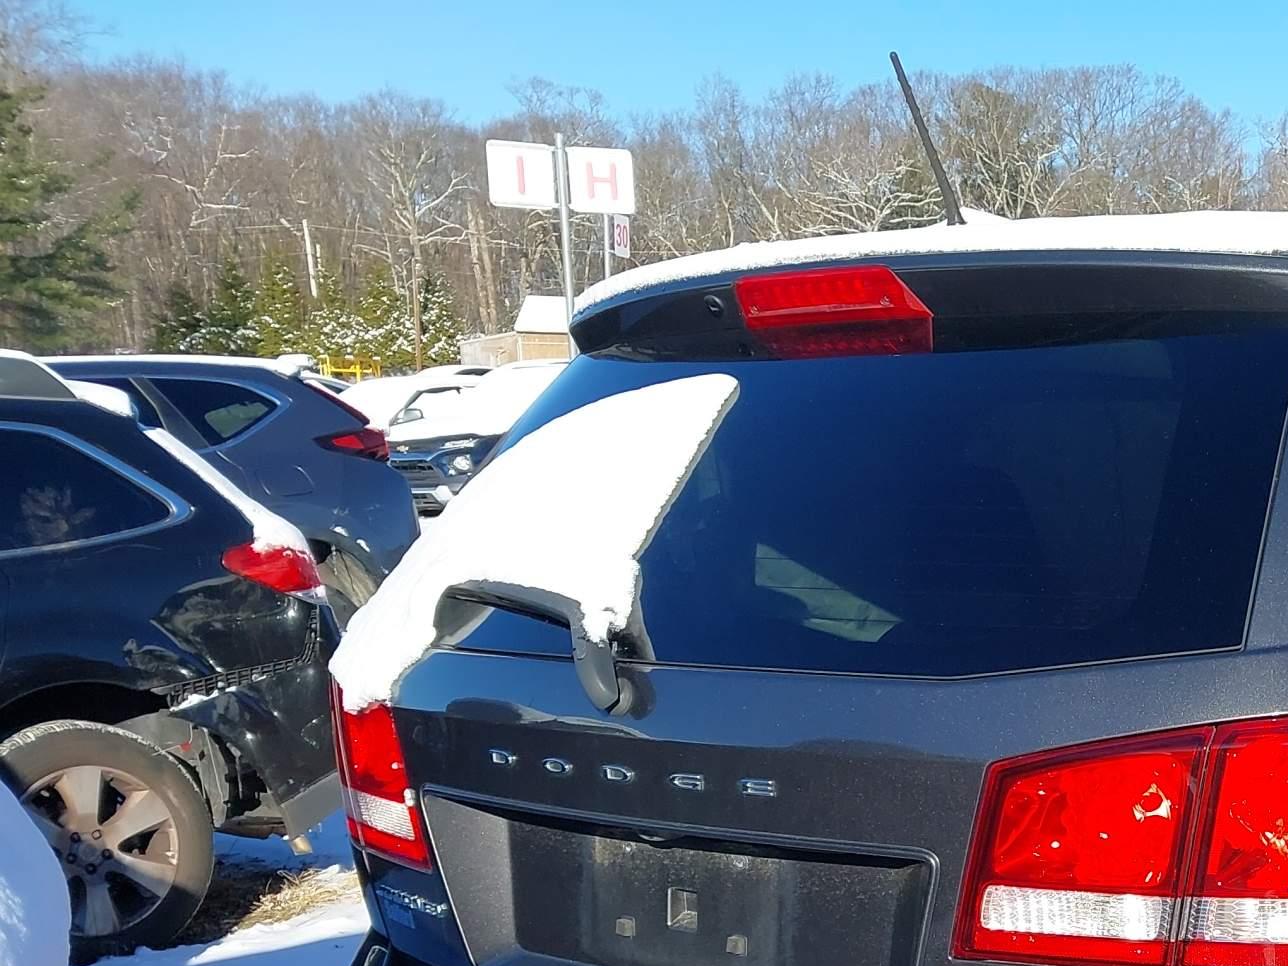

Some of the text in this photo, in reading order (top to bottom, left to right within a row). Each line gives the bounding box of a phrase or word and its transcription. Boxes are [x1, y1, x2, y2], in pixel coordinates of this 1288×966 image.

[586, 162, 618, 200] H
[615, 224, 628, 249] 30
[489, 749, 776, 797] DODGE
